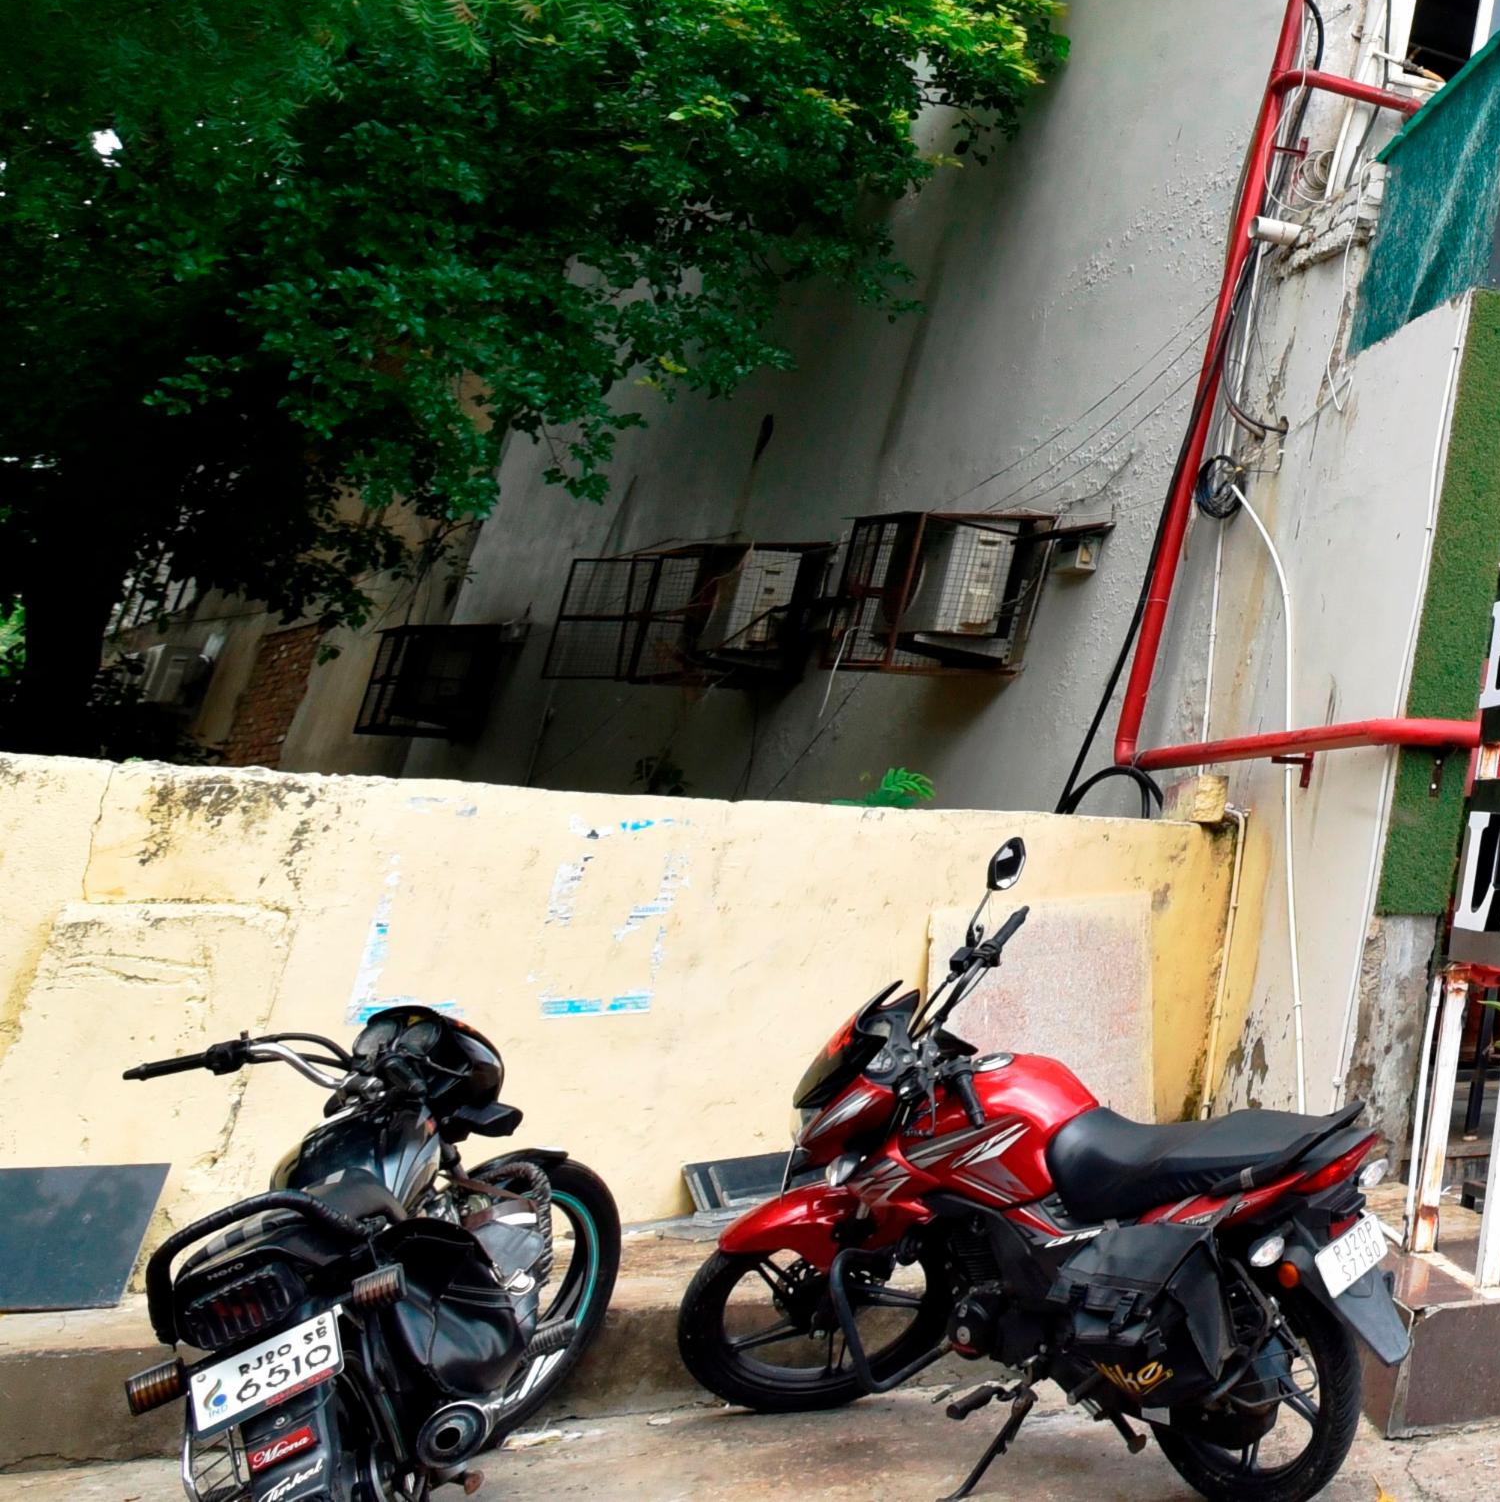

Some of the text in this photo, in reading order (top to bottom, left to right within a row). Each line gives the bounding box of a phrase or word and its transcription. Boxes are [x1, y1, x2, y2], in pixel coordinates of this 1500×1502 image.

[1332, 1220, 1372, 1264] RJ20P
[302, 1325, 328, 1346] SB
[236, 1344, 332, 1404] 6510
